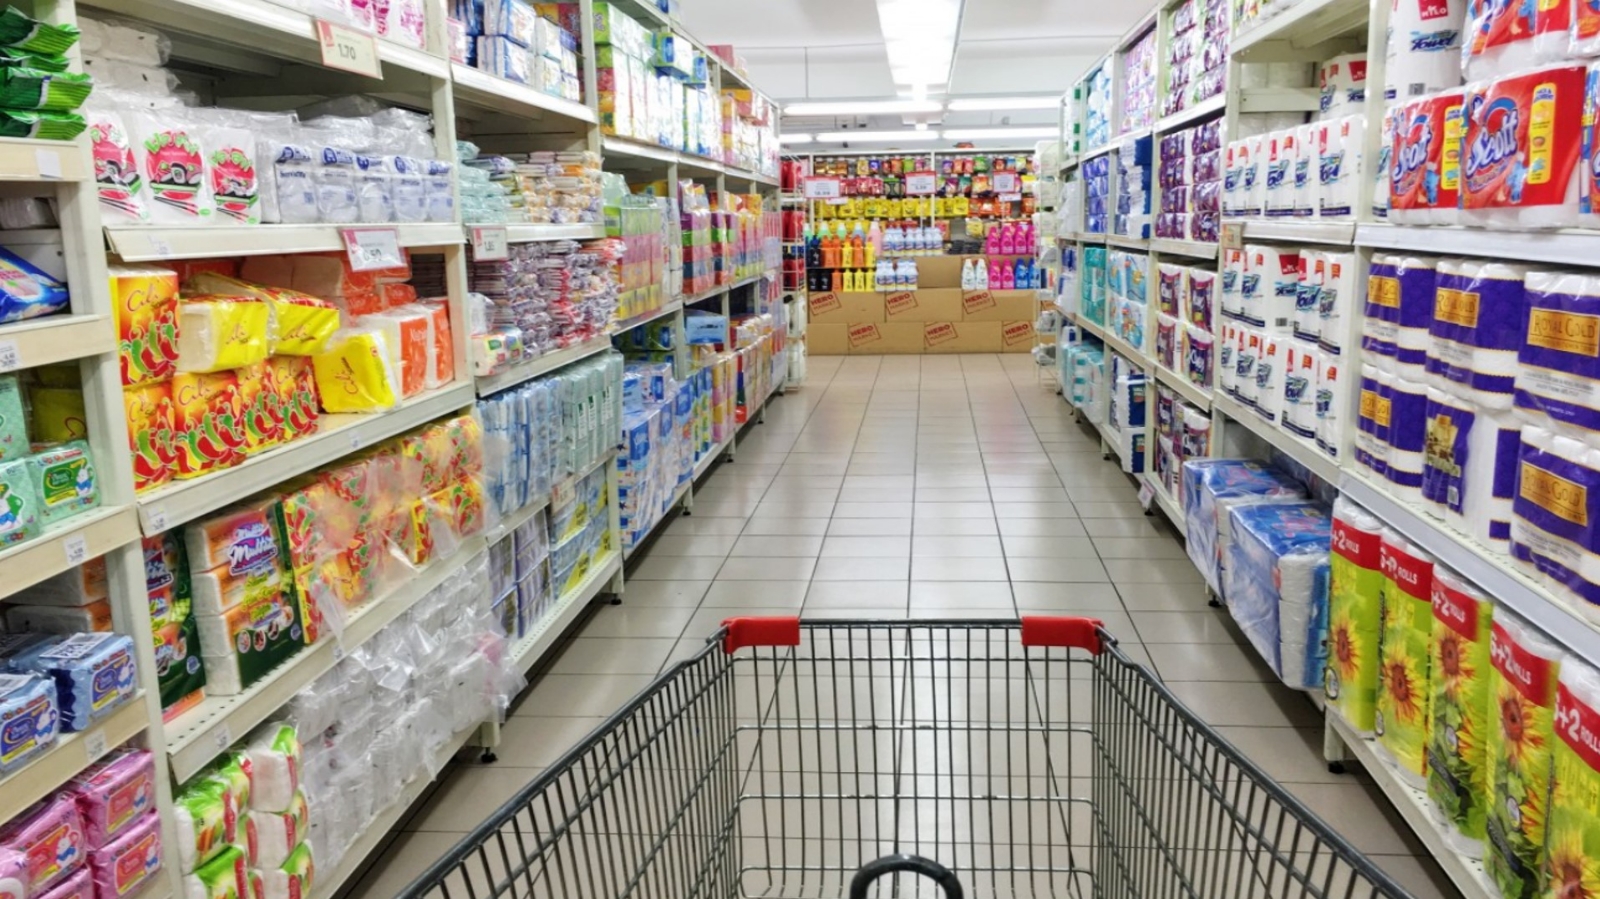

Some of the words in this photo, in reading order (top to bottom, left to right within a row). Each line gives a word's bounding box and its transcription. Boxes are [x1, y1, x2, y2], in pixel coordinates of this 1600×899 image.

[338, 43, 356, 61] 1.70
[1466, 109, 1518, 180] Scott
[811, 294, 834, 306] HERO
[887, 293, 911, 305] HERO
[965, 292, 989, 304] HERO
[850, 325, 874, 337] HERO
[927, 324, 951, 336] HERO
[1004, 324, 1029, 336] HERO
[1533, 314, 1563, 336] ROYAL
[1565, 317, 1596, 339] GOLD
[1551, 480, 1582, 508] GOLD
[1397, 566, 1418, 585] ROLLS
[1490, 631, 1513, 675] 6+2
